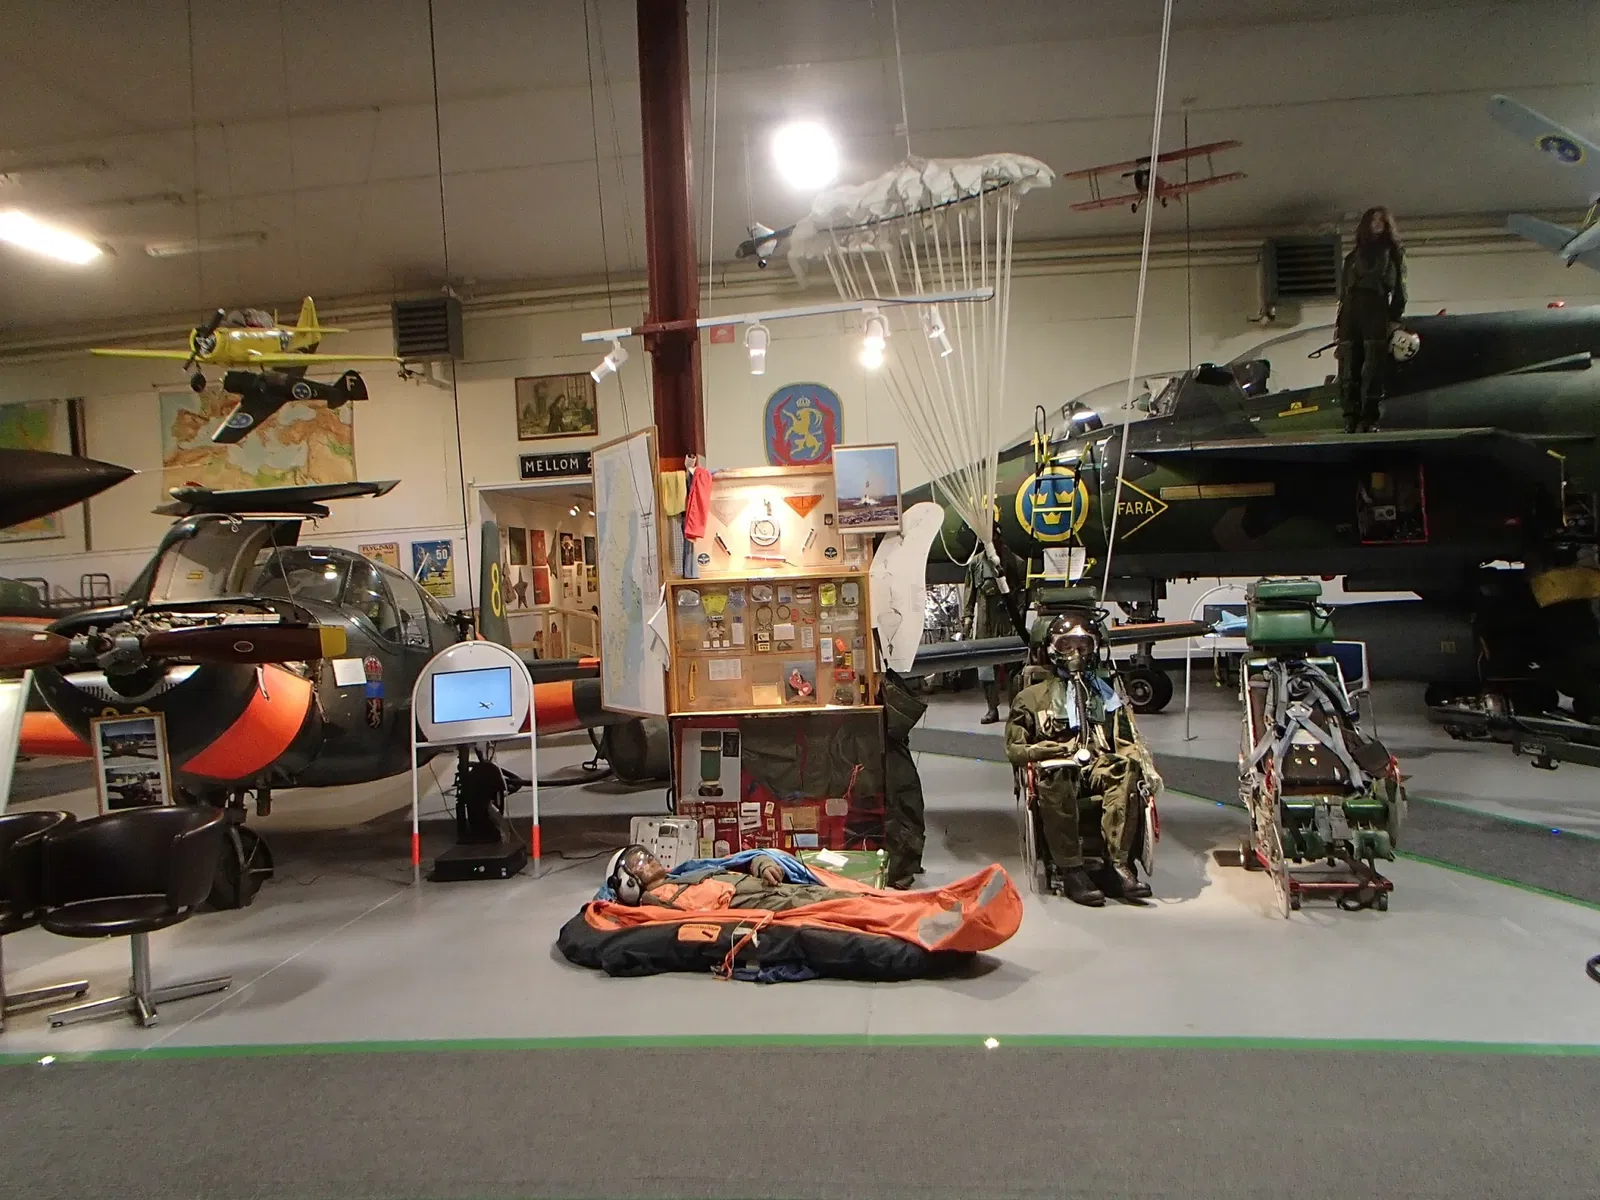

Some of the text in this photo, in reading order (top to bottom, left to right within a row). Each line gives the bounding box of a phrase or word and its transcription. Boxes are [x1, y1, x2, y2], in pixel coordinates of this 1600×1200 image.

[525, 458, 579, 472] MELLOM
[1117, 501, 1154, 515] FARA
[436, 548, 448, 560] 50
[491, 562, 501, 618] 8
